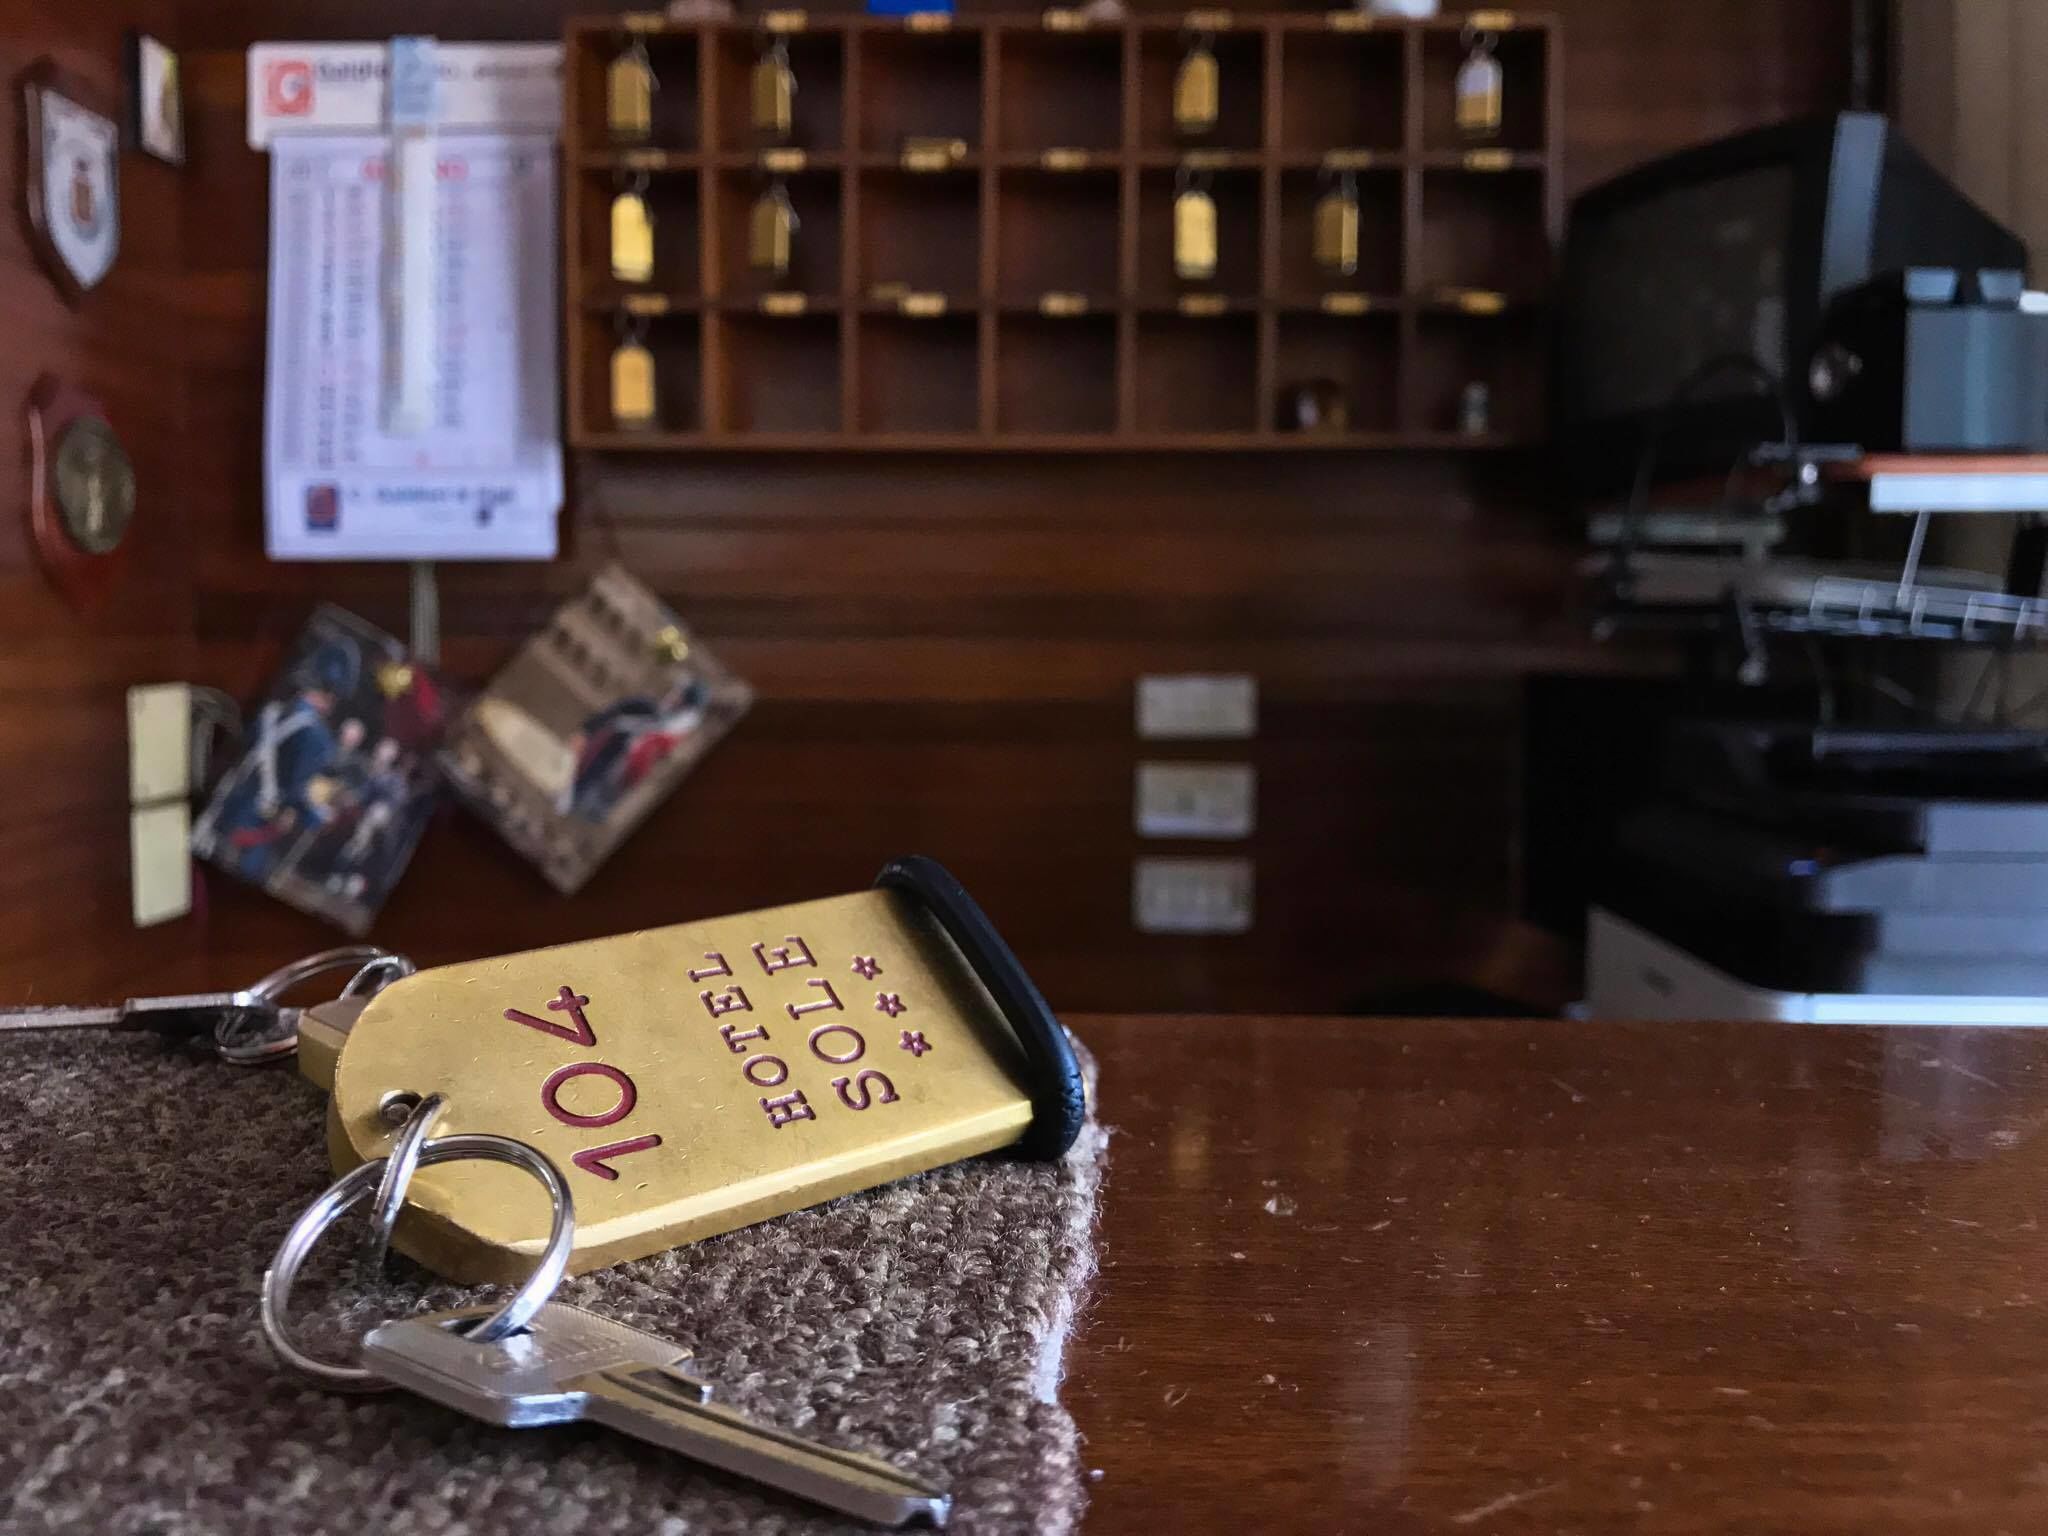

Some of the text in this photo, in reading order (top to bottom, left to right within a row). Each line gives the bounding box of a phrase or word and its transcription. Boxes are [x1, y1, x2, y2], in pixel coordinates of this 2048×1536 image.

[503, 985, 663, 1181] 104
[687, 951, 817, 1129] HOTEL
[751, 936, 900, 1111] SOLE
